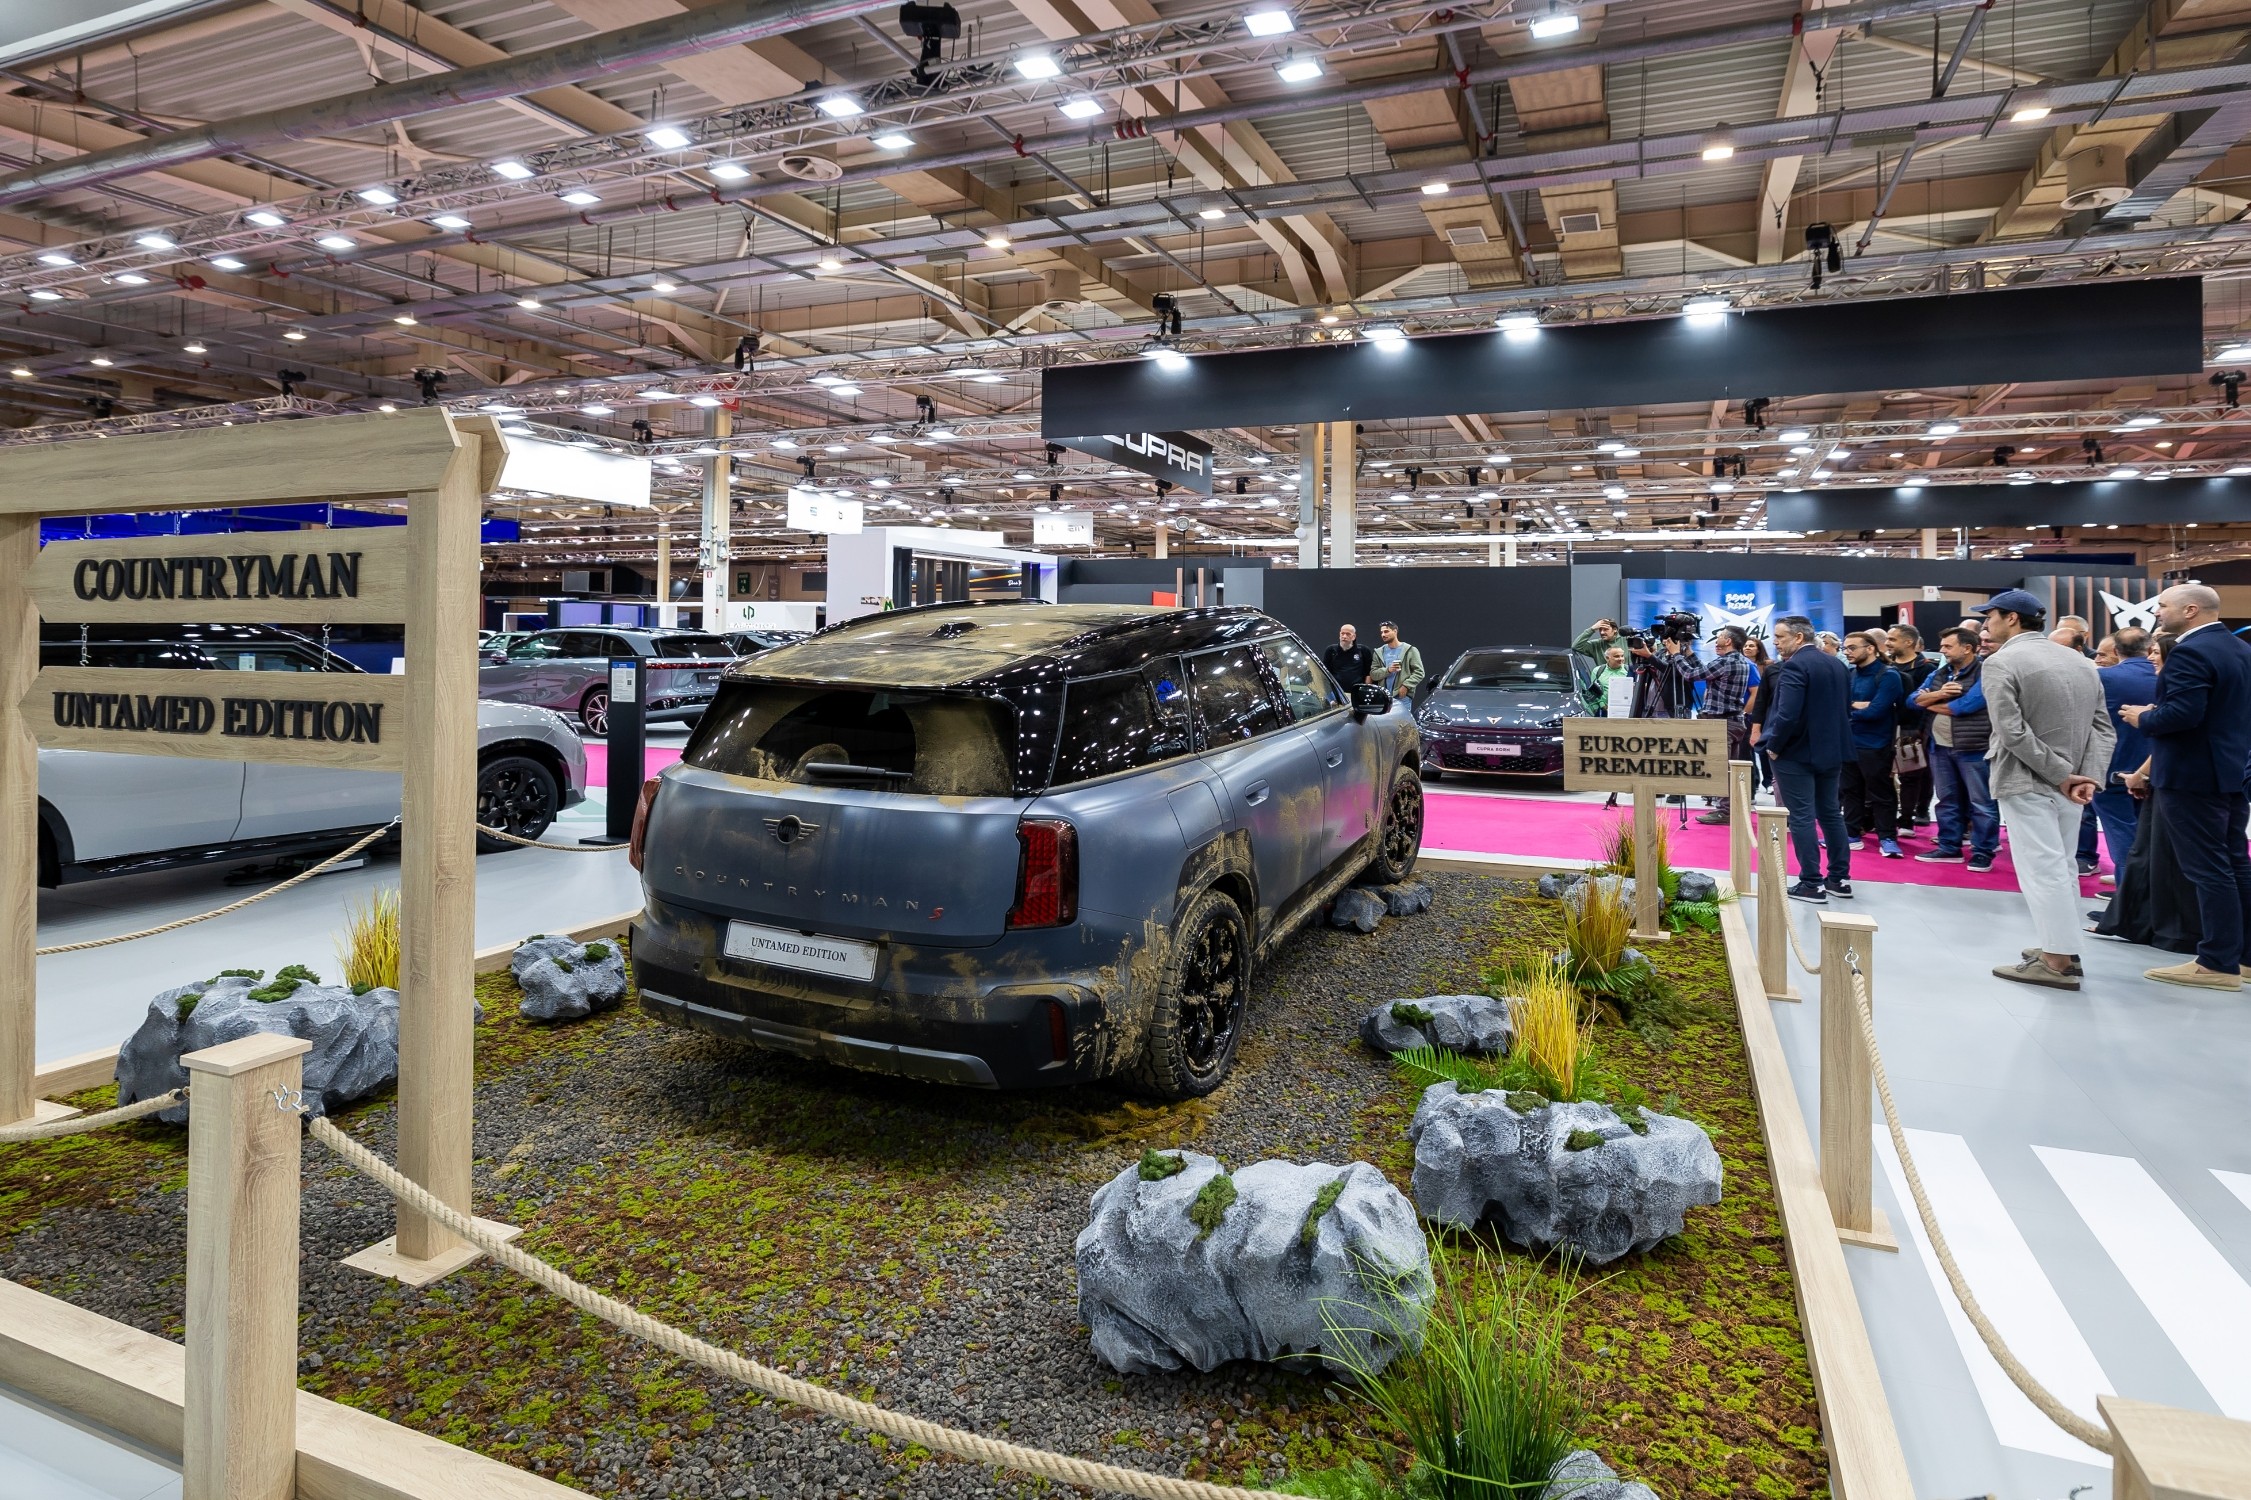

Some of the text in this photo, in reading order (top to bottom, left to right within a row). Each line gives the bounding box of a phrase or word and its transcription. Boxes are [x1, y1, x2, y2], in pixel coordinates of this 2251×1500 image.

[73, 552, 362, 601] COUNTRYMAN
[52, 692, 384, 743] UNTAMED EDITION
[1579, 736, 1709, 755] EUROPEAN
[1579, 757, 1712, 779] PREMIERE.
[674, 866, 944, 919] COUNTRYMAN S
[751, 936, 848, 963] UNTAMED EDITION
